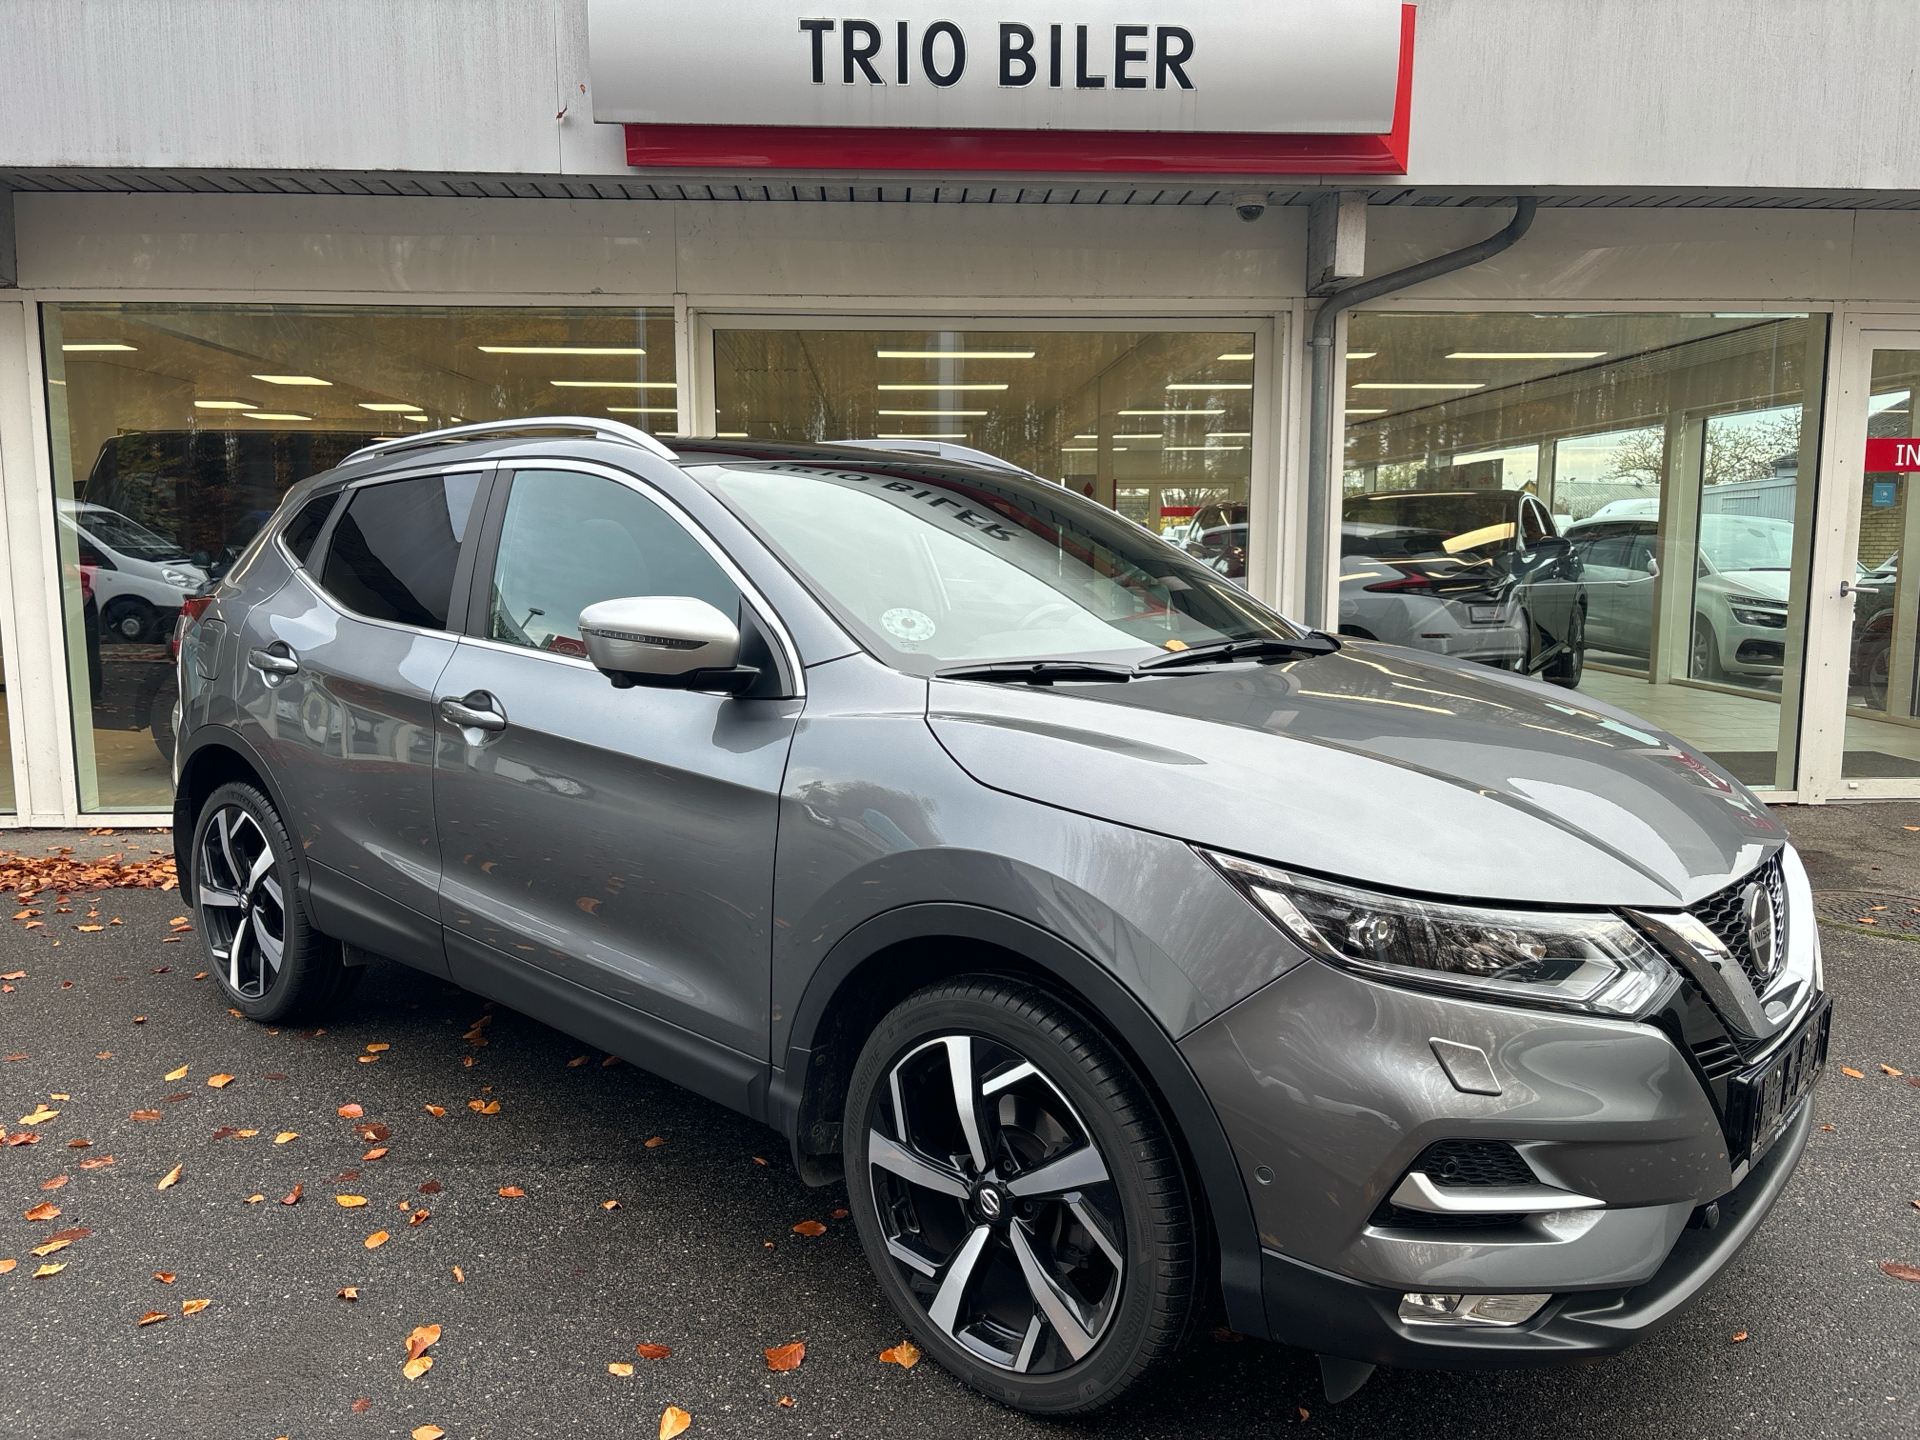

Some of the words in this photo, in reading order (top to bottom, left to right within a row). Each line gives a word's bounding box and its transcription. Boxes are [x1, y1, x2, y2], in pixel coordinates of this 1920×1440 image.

[798, 18, 967, 88] TRIO
[998, 22, 1197, 90] BILER
[1754, 924, 1771, 944] NISS
[848, 1047, 883, 1143] BRIDGESTONE
